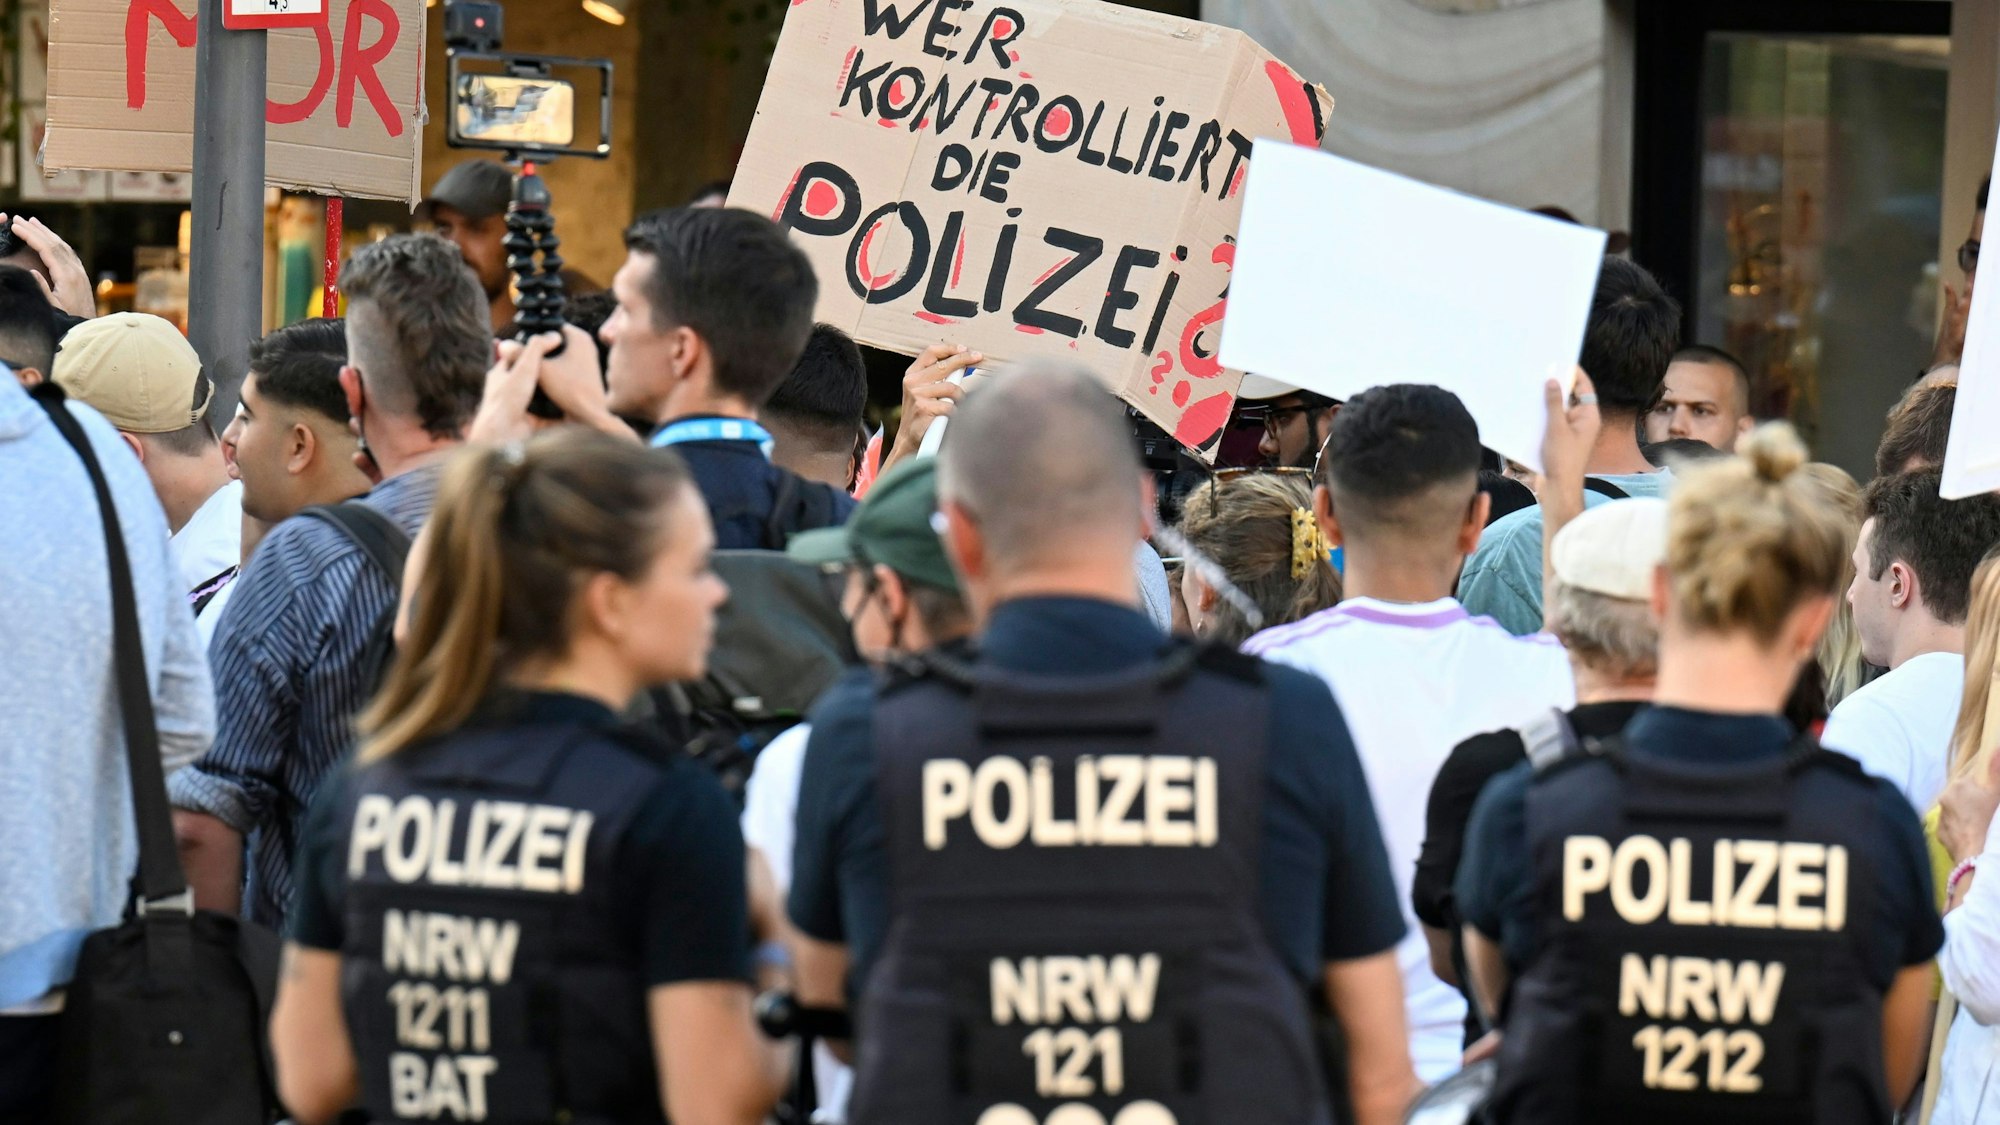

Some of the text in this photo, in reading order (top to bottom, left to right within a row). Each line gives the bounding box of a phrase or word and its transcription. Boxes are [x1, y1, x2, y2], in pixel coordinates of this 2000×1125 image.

[864, 0, 1025, 69] WER
[931, 143, 1021, 203] DIE
[922, 755, 1219, 850] POLIZEI
[347, 793, 594, 893] POLIZEI
[1562, 834, 1849, 932] POLIZEI
[383, 909, 520, 985] NRW
[388, 982, 491, 1052] 1211
[990, 953, 1161, 1024] NRW
[1618, 953, 1785, 1025] NRW
[389, 1052, 498, 1120] BAT
[1022, 1027, 1124, 1096] 121
[1633, 1026, 1765, 1092] 1212
